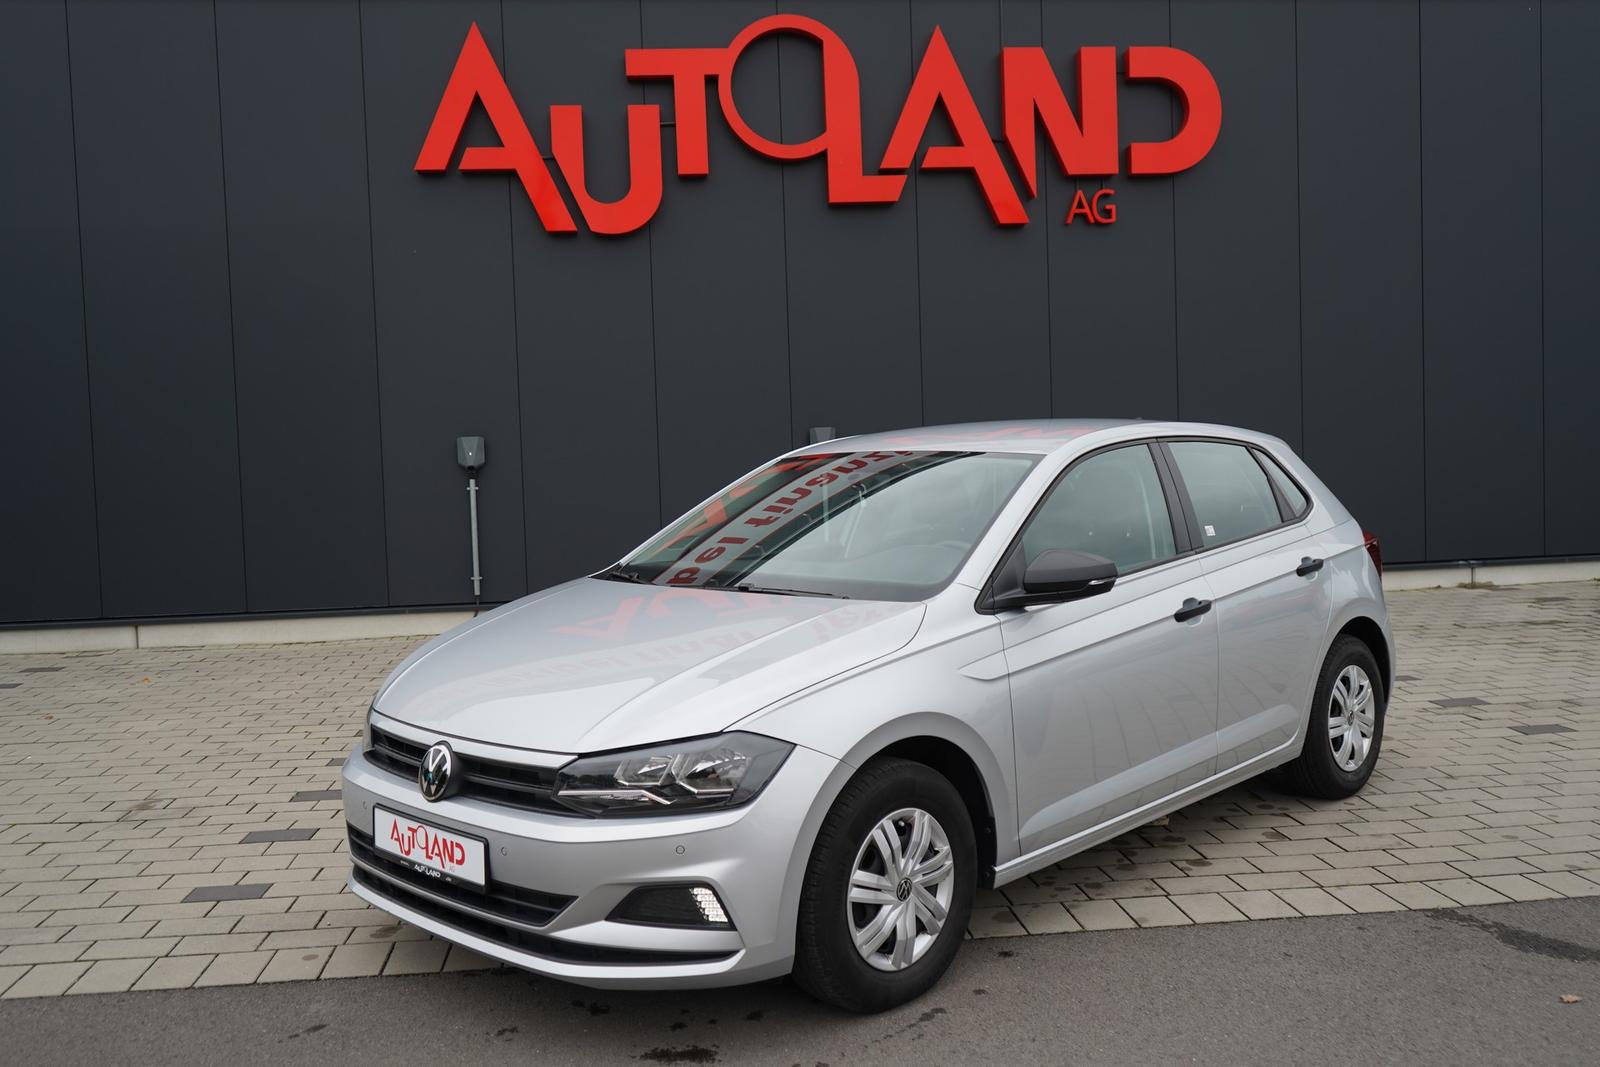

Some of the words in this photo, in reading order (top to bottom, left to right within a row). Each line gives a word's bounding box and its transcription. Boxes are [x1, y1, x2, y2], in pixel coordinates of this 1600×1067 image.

[415, 14, 1222, 235] AUTOLAND
[1066, 189, 1118, 225] AG
[390, 818, 466, 869] AUTOLAND
